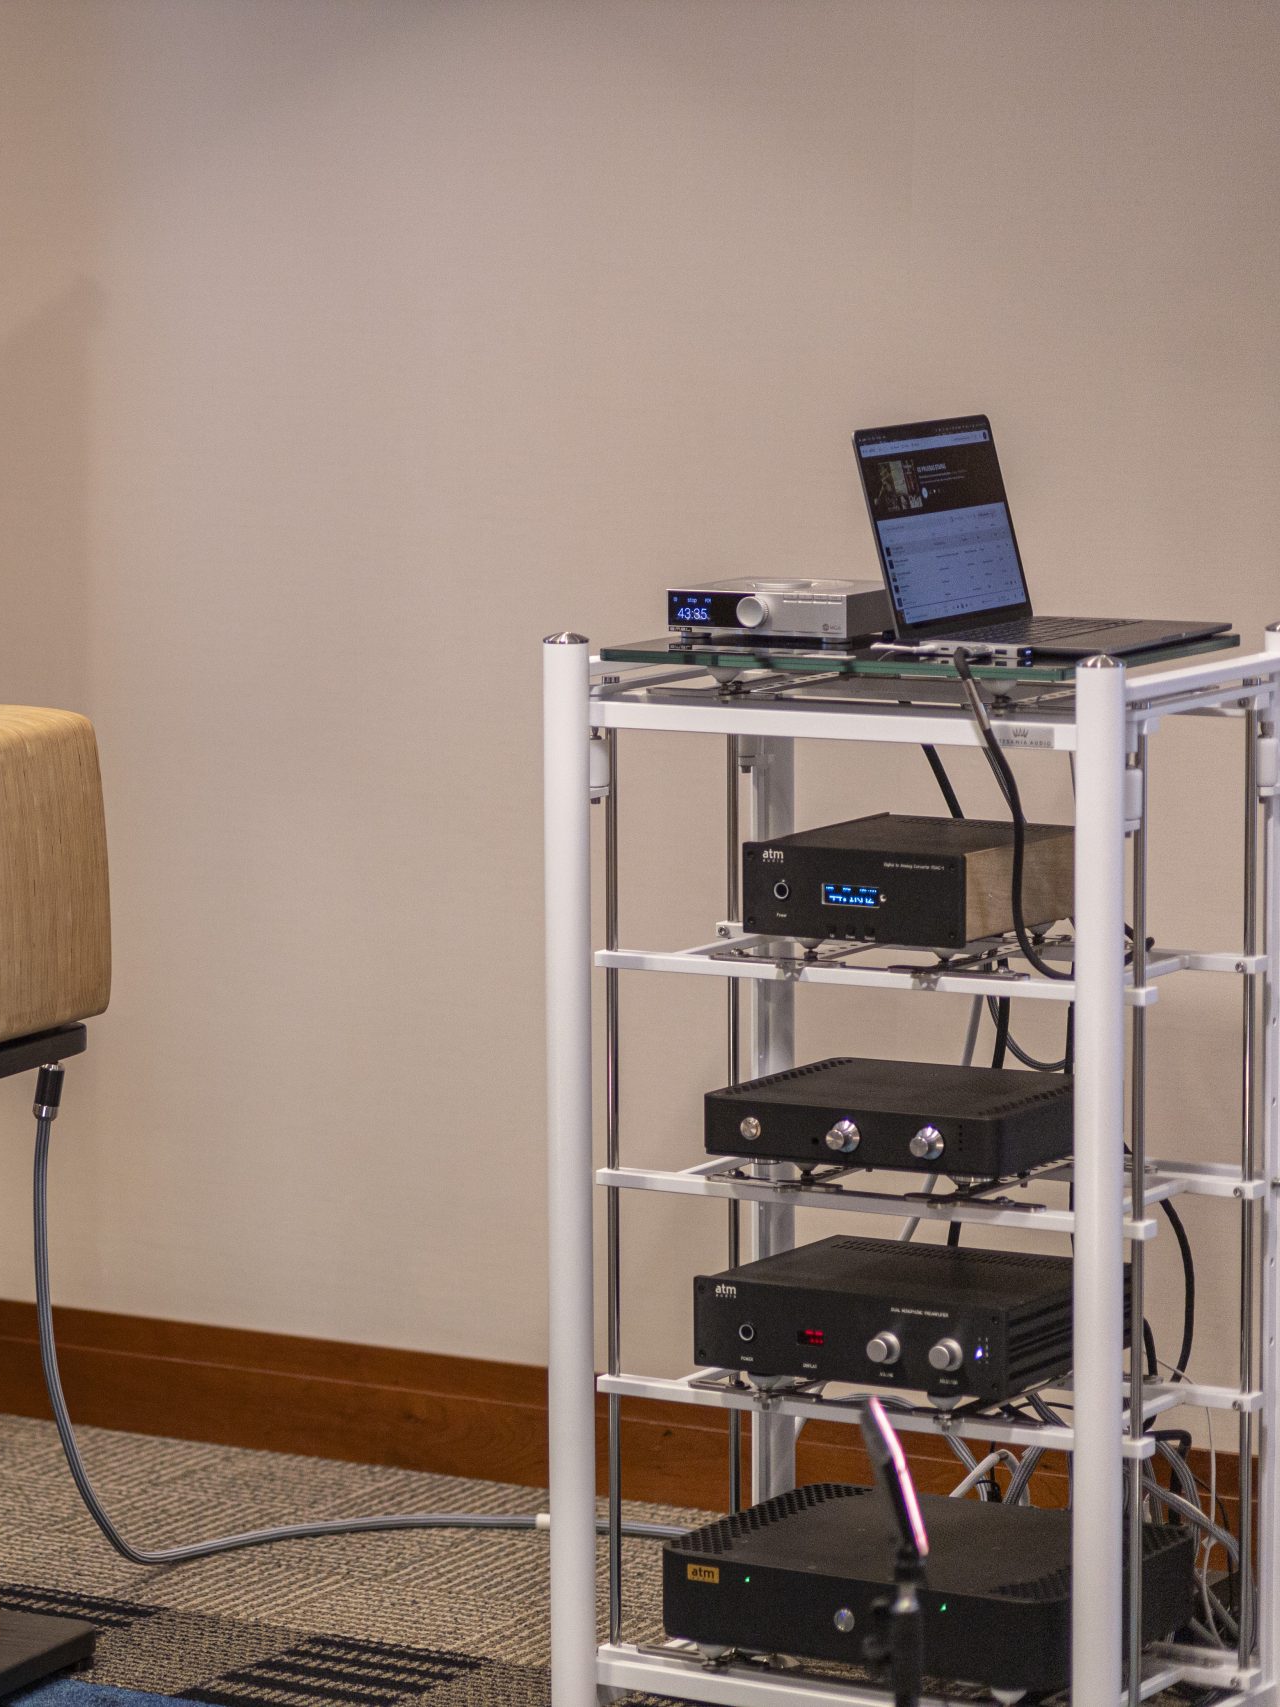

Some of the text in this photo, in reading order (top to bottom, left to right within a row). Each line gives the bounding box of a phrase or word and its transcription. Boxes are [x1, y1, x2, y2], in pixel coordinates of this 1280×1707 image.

[762, 848, 784, 859] atm
[715, 1283, 737, 1294] atm
[691, 1567, 715, 1579] atm
